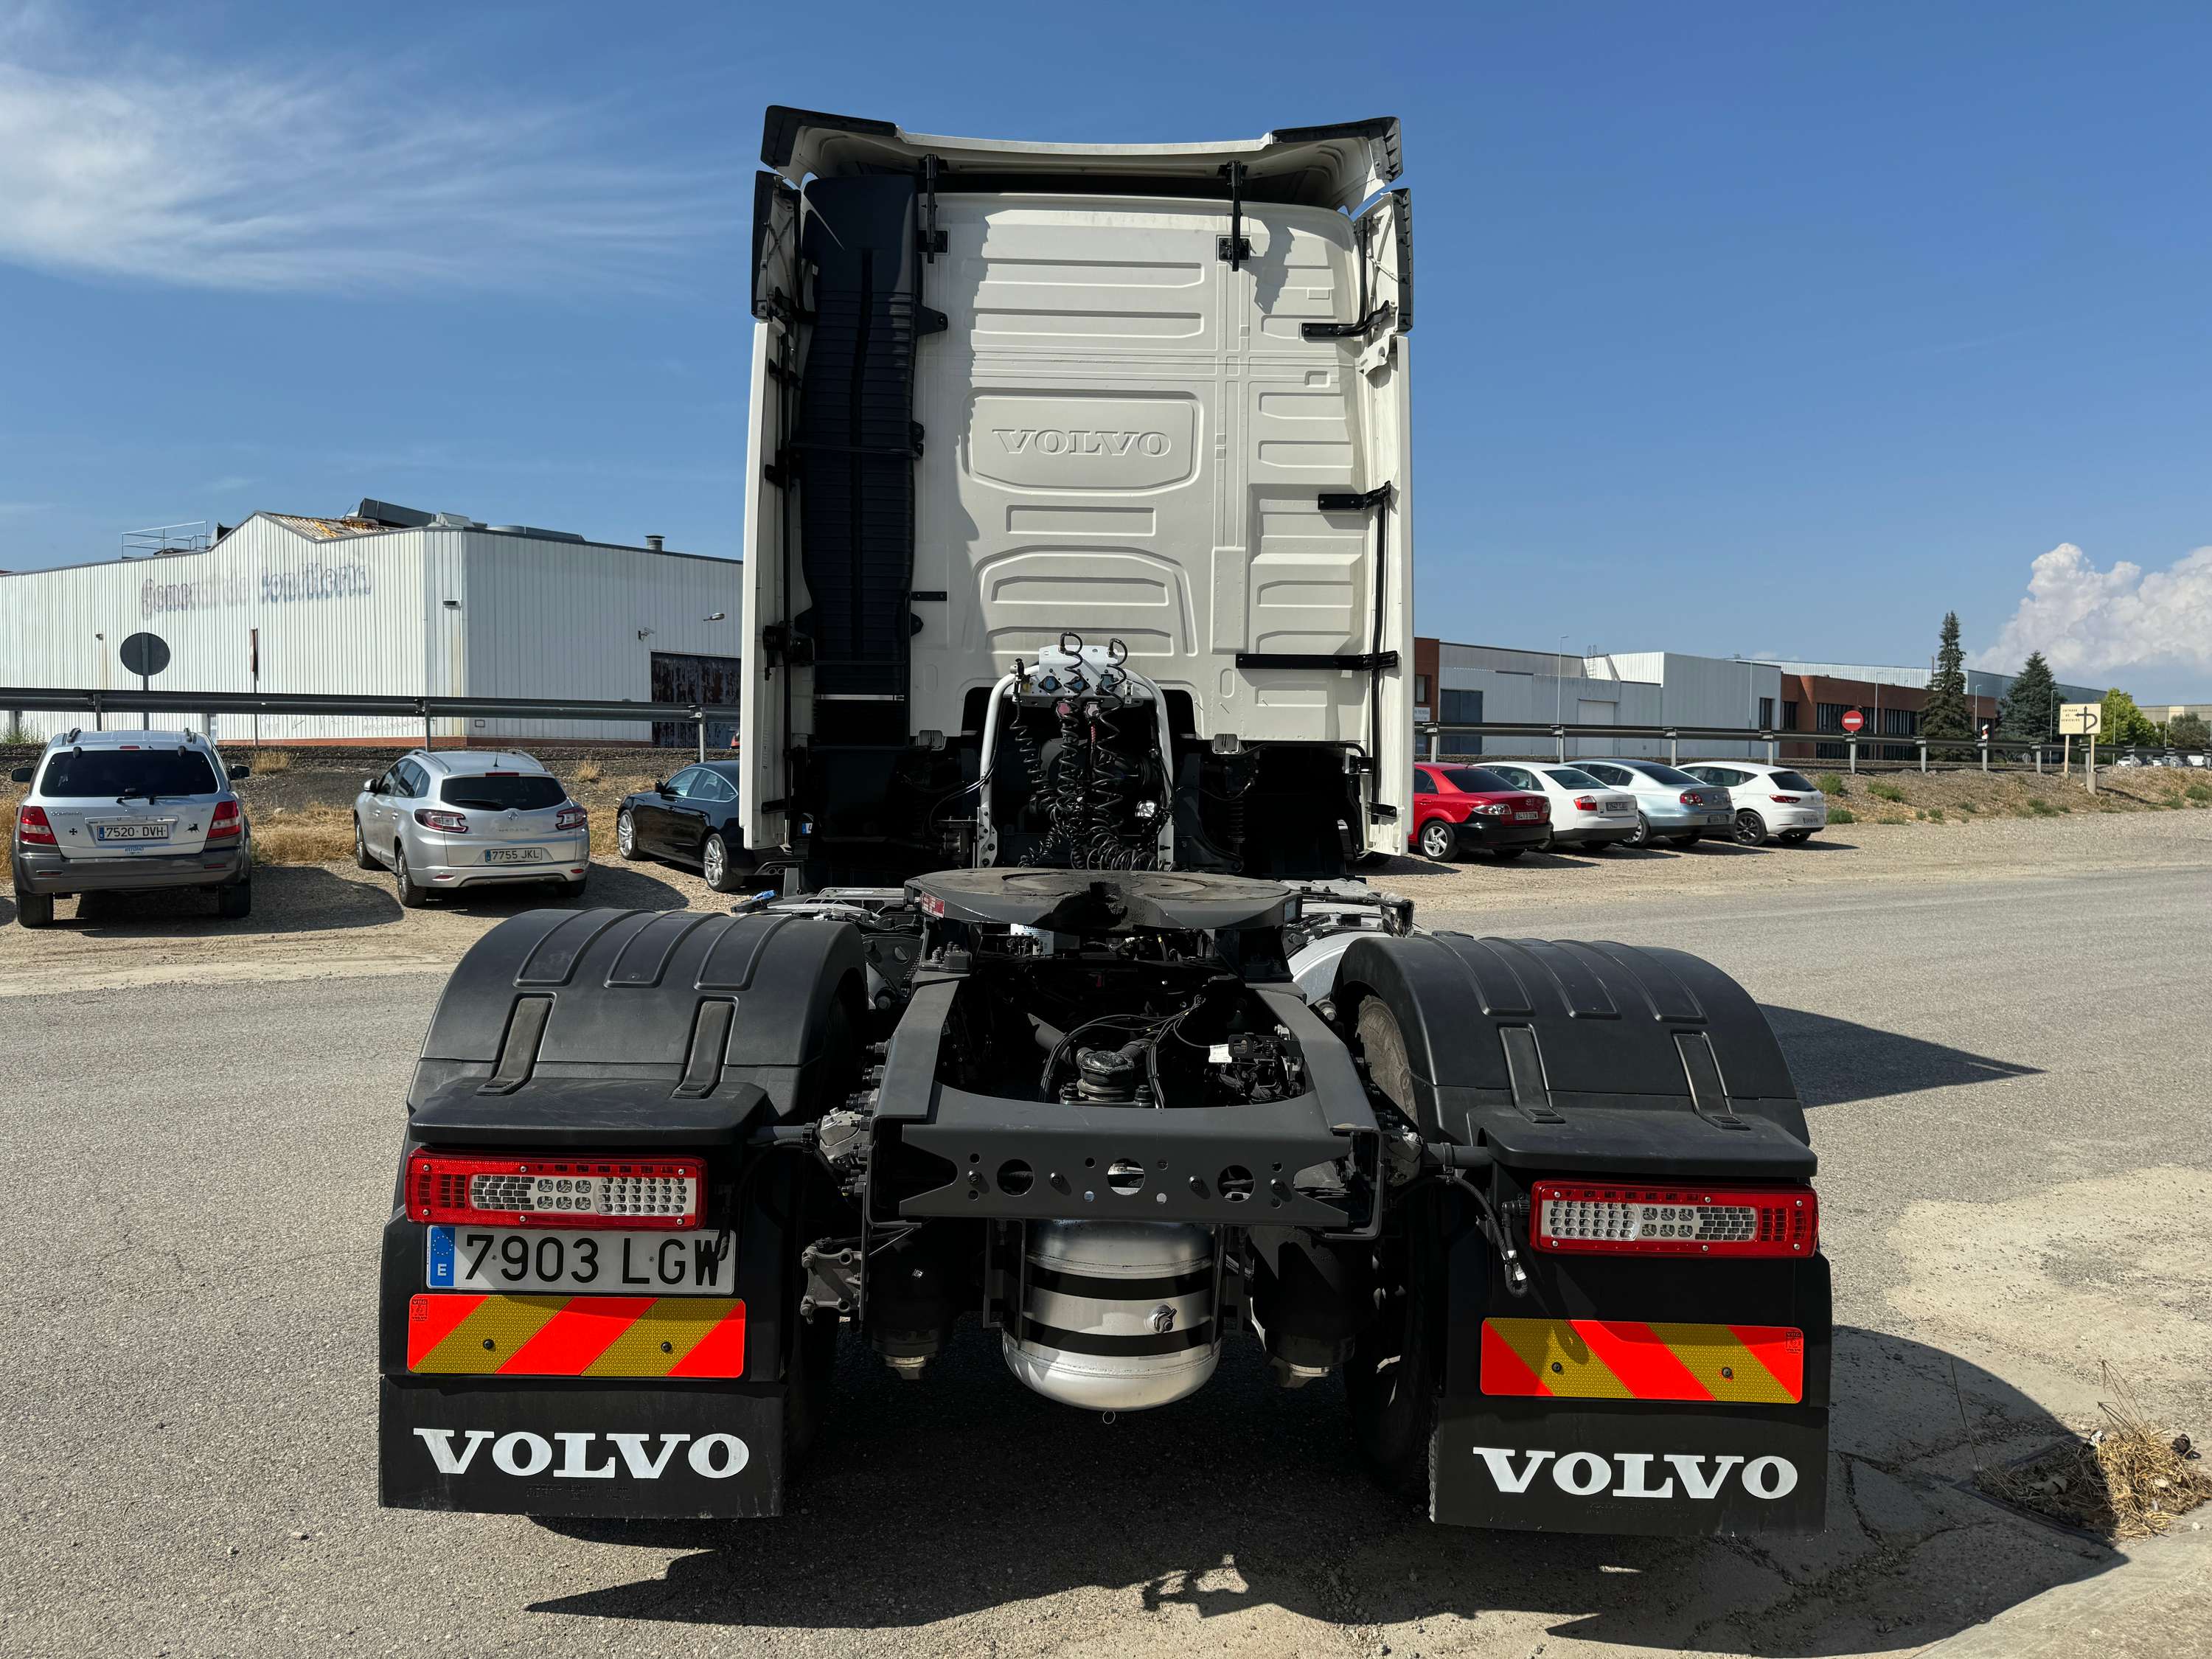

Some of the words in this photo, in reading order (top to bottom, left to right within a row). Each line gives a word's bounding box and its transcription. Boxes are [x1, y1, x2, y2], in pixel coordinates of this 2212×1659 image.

[992, 428, 1172, 456] VOLVO
[106, 827, 135, 838] 7520
[142, 826, 164, 837] DVH
[492, 851, 518, 860] 7755
[521, 849, 539, 859] JKL
[437, 1263, 448, 1276] E
[465, 1234, 599, 1283] 7903
[622, 1238, 721, 1287] LGW
[414, 1428, 750, 1479] VOLVO
[1472, 1447, 1798, 1500] VOLVO
